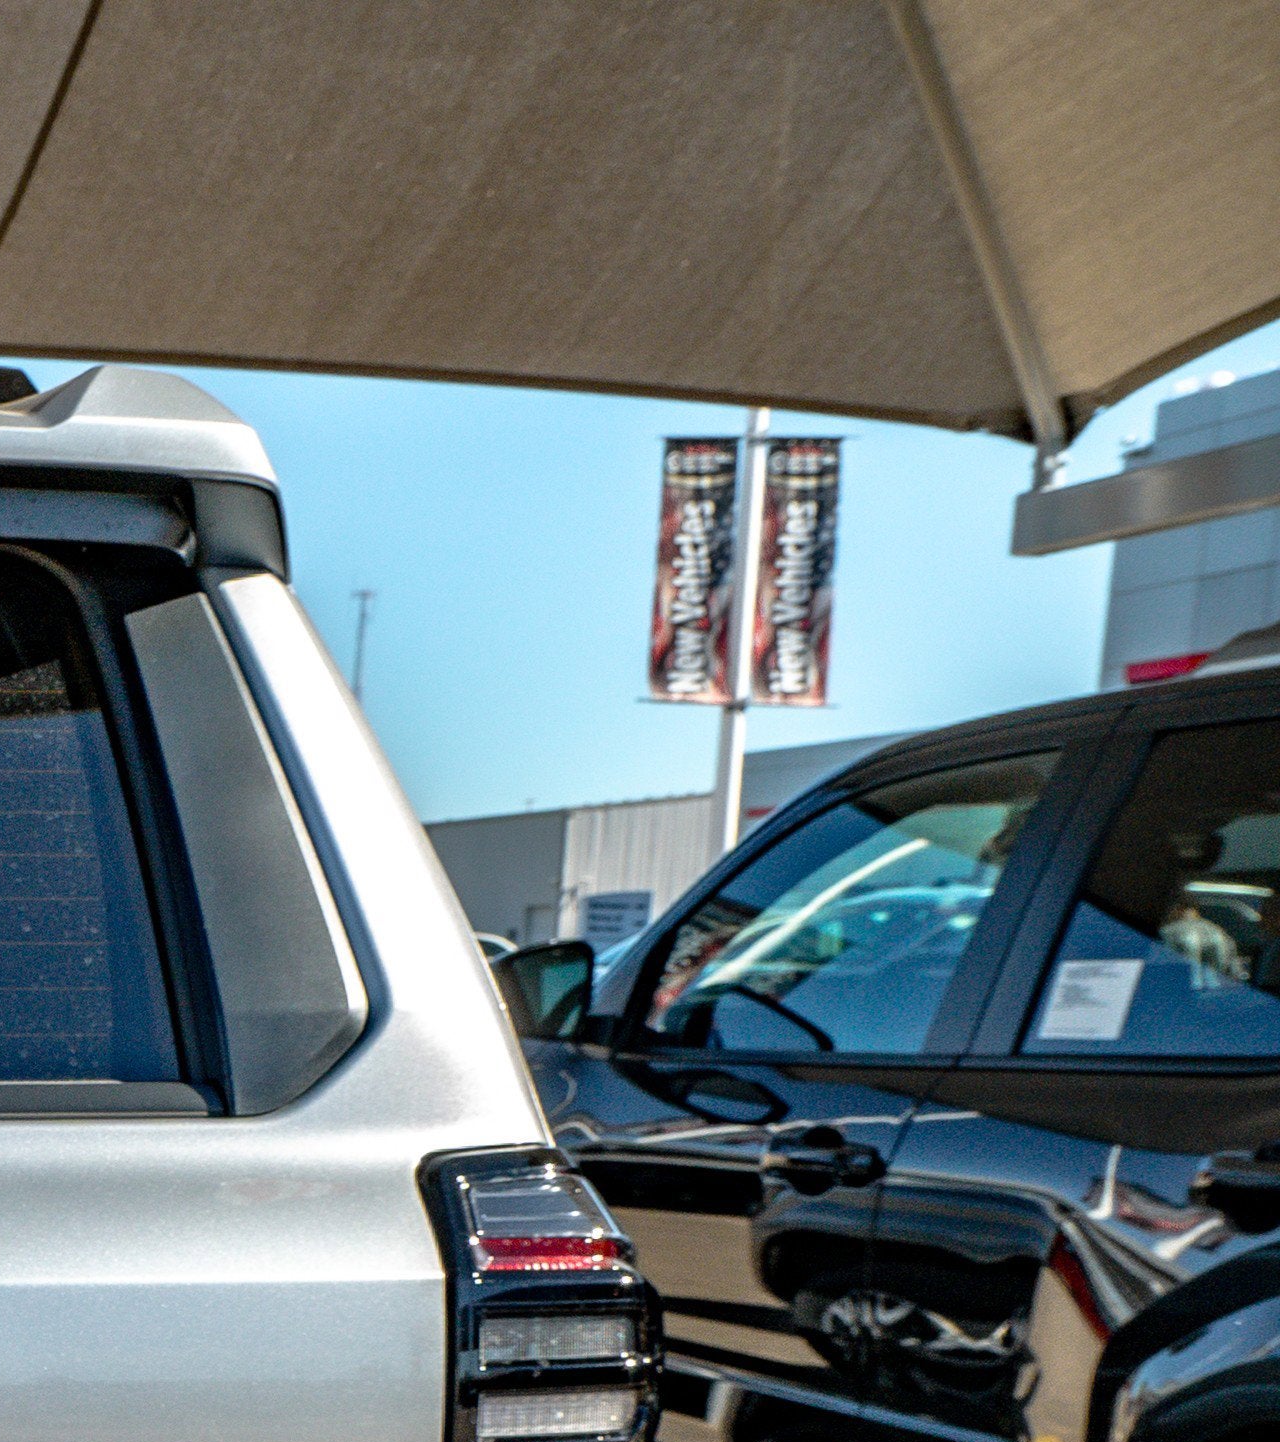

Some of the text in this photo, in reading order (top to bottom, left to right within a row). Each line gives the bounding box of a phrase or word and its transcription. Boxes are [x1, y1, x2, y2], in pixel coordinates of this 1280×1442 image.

[671, 500, 716, 626] Vehicles
[771, 500, 819, 626] Vehicles
[666, 627, 707, 693] New
[769, 627, 808, 693] New
